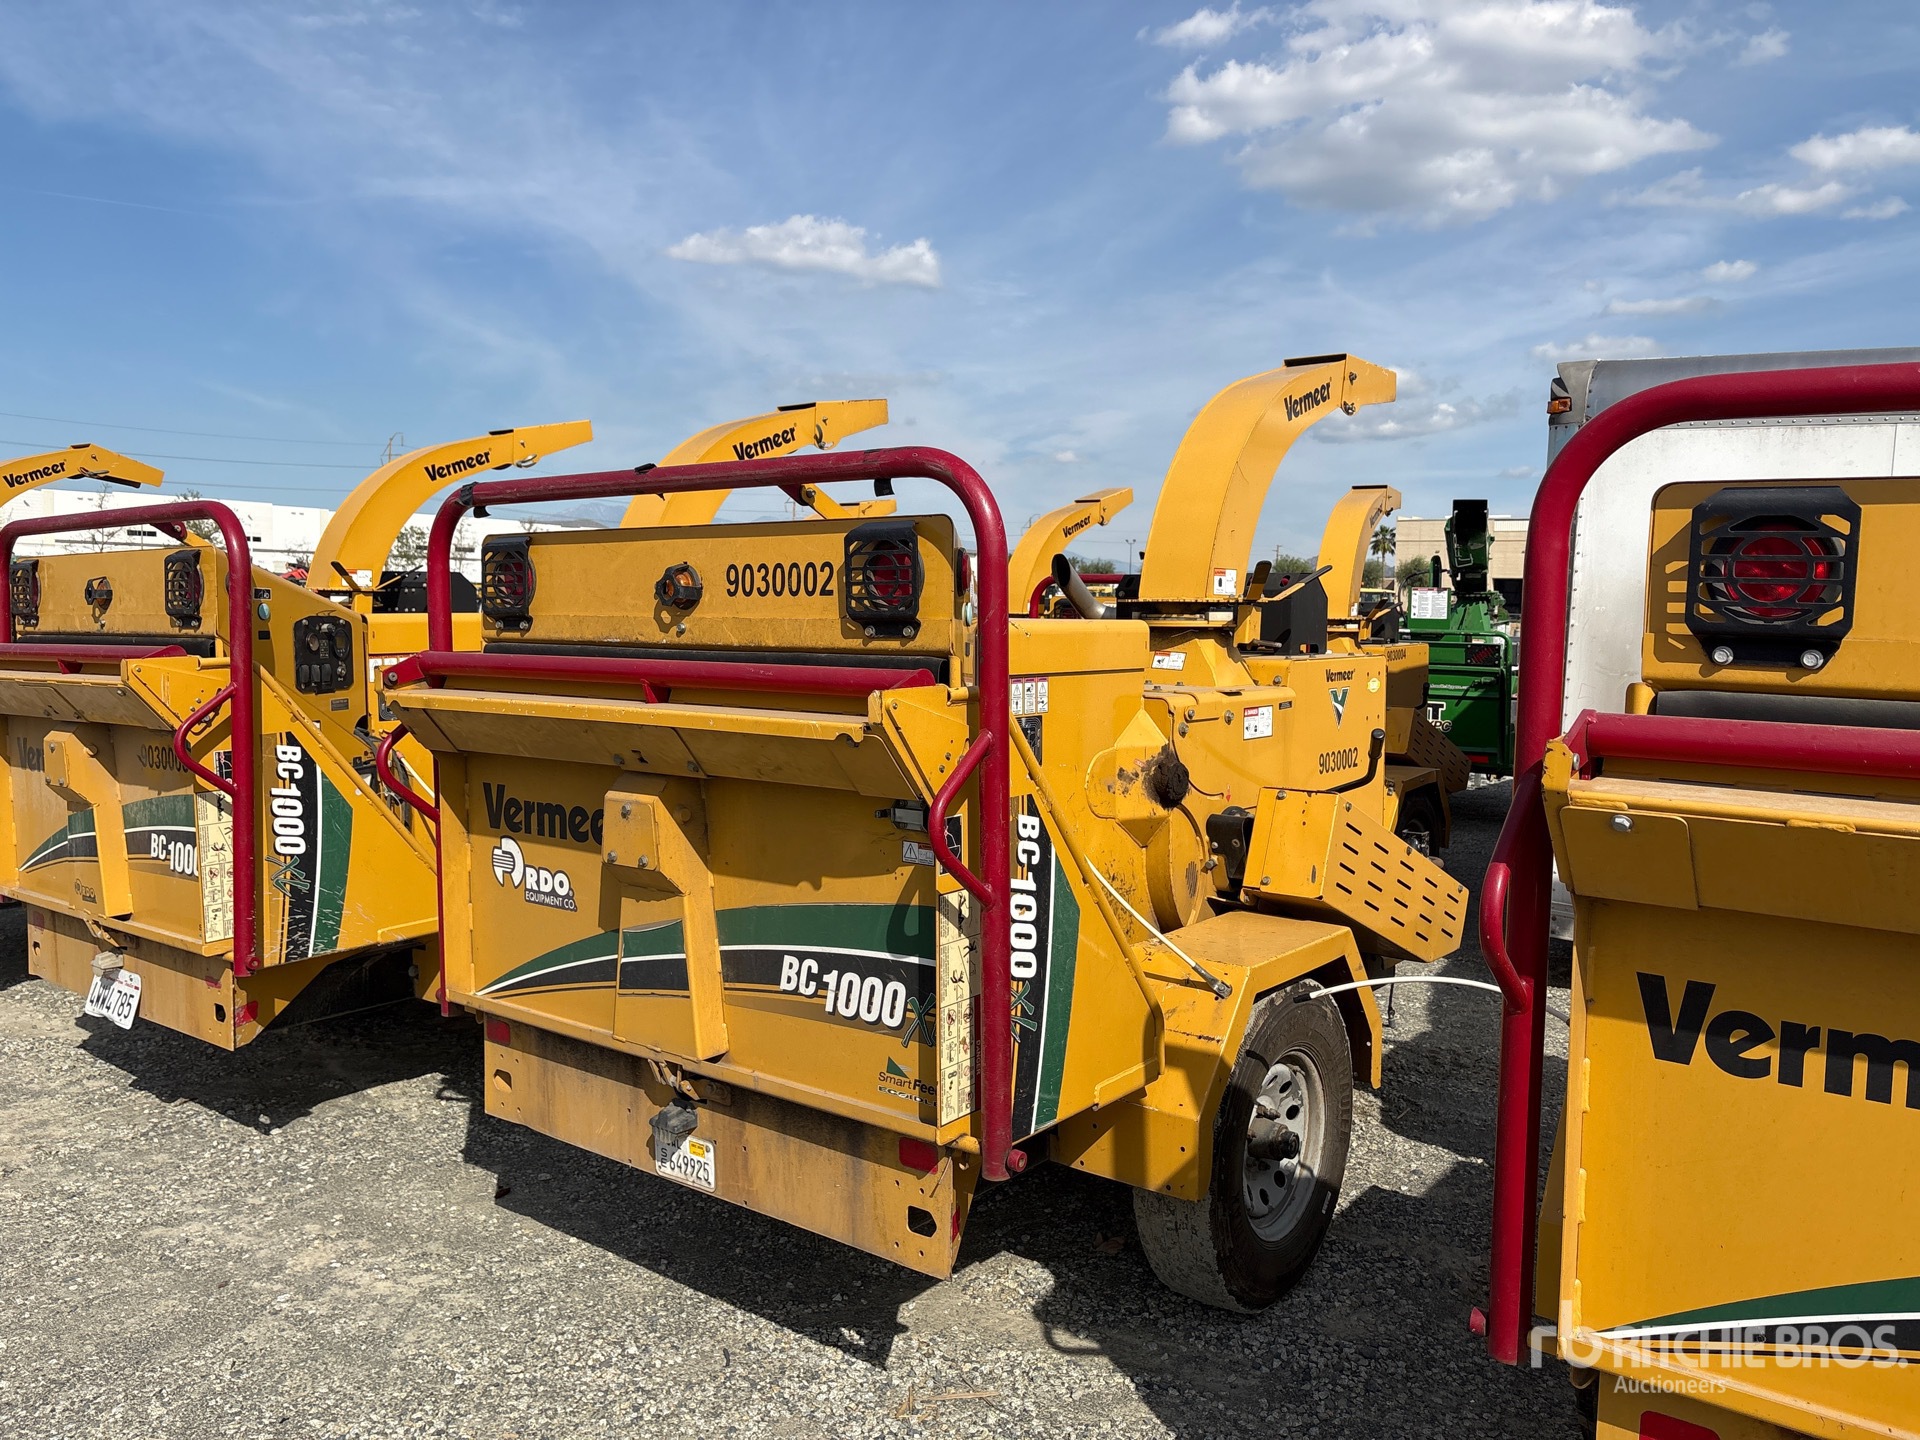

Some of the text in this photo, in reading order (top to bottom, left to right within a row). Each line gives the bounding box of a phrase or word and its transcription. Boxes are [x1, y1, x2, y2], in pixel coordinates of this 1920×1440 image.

[1284, 381, 1331, 421] Vermeer
[732, 424, 796, 460] Vermeer
[2, 462, 65, 488] Vermeer
[424, 451, 490, 481] Vermeer
[1062, 515, 1091, 538] Vermeer
[726, 561, 834, 597] 9030002
[1325, 669, 1354, 682] Vermeer
[1319, 747, 1358, 775] 9030002
[525, 891, 577, 911] EQUIPMENT CO.
[90, 981, 135, 1020] 4WW4785
